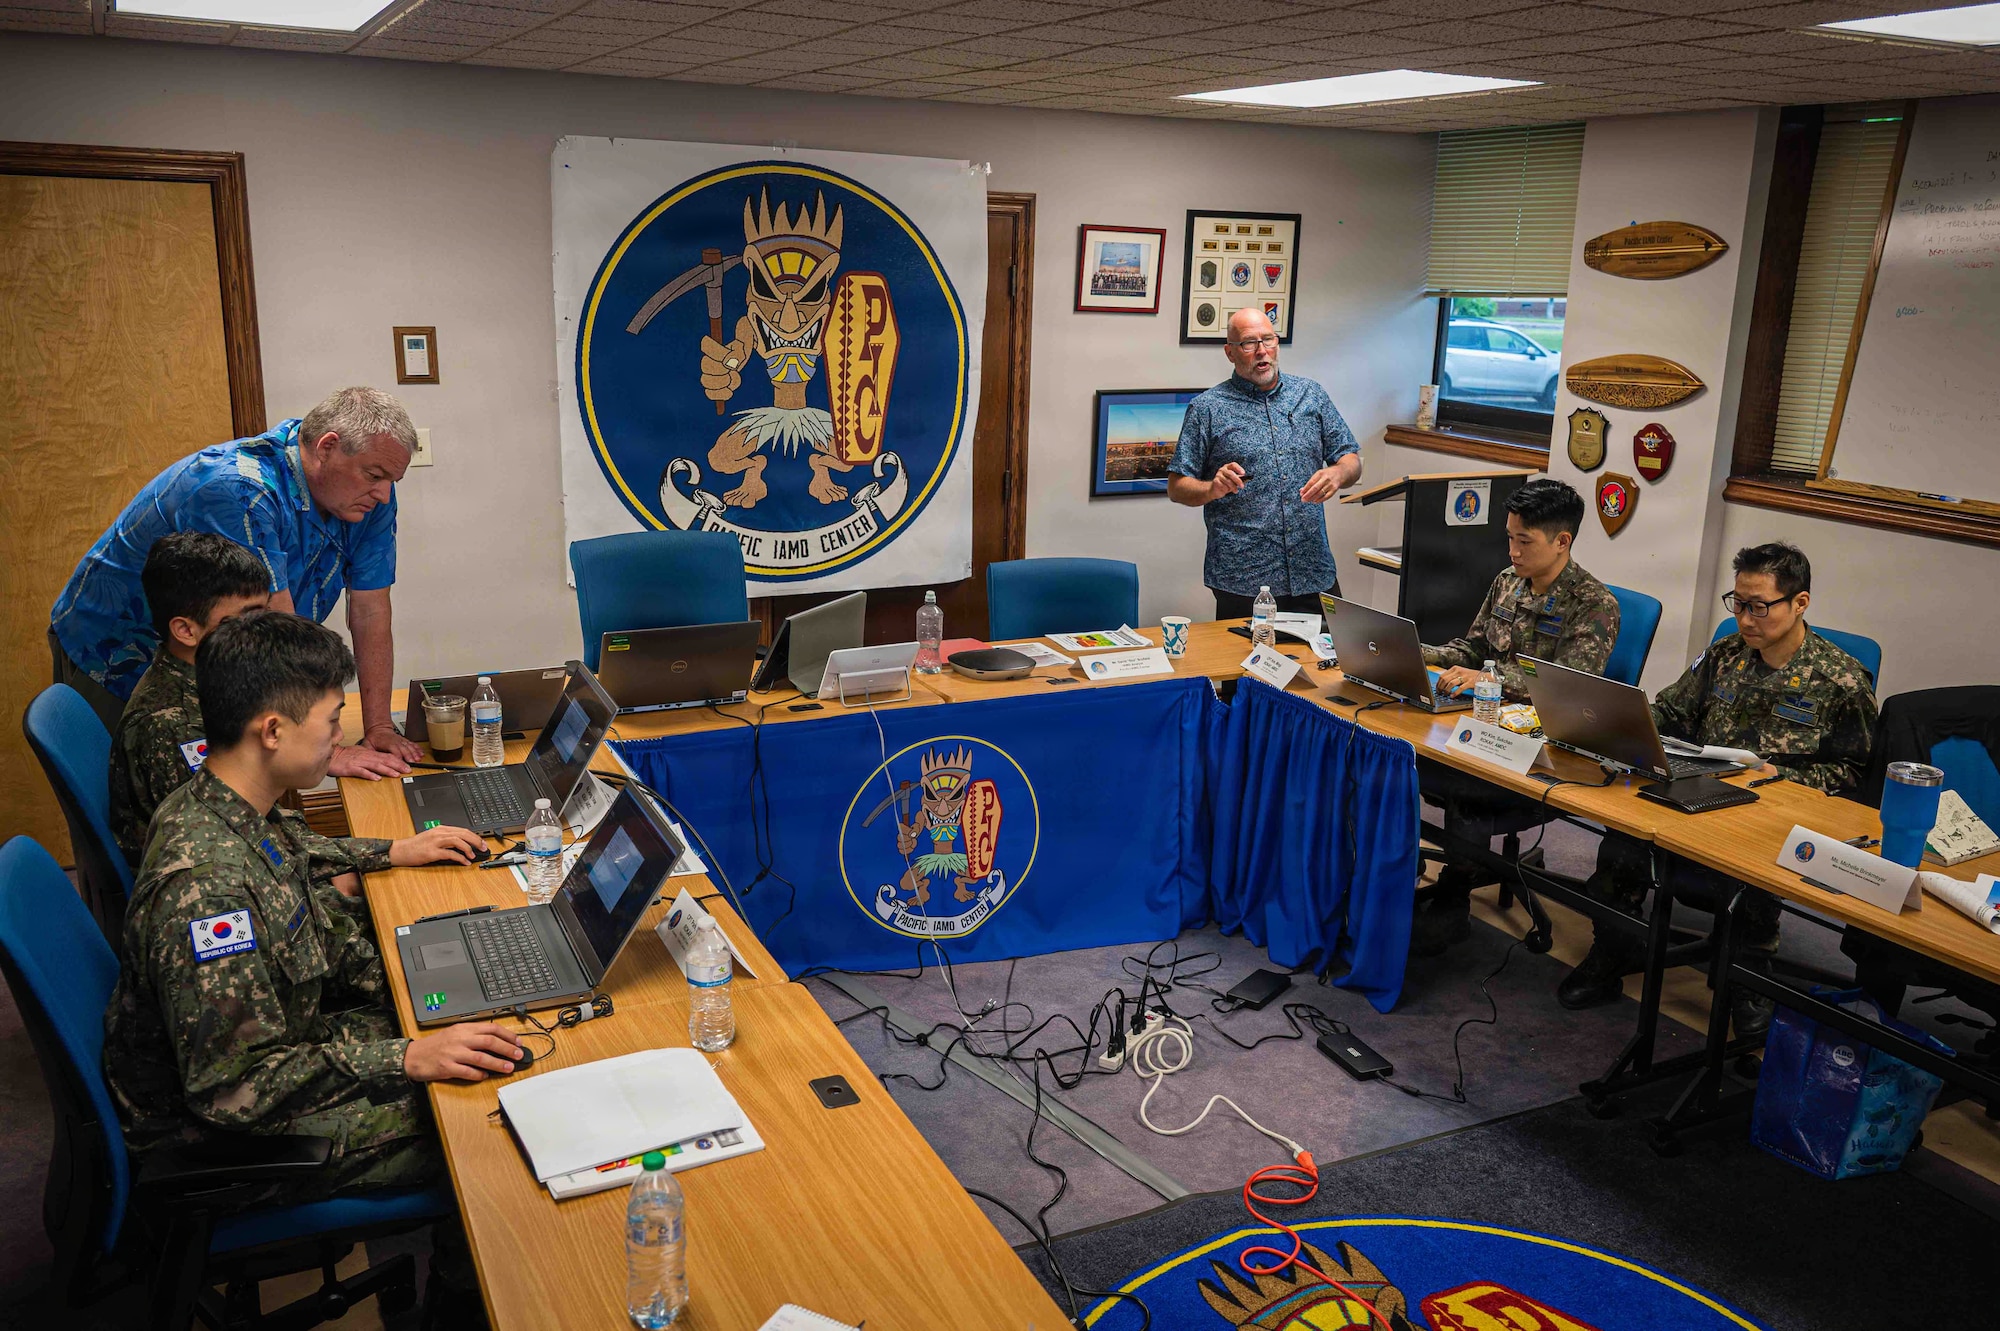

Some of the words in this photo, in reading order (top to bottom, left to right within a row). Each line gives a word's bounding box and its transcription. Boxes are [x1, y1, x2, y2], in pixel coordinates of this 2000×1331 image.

[820, 514, 874, 553] CENTER
[1840, 859, 1860, 872] Michelle
[897, 913, 928, 931] PACIFIC
[960, 903, 987, 929] CENTER
[200, 948, 226, 959] REPUBLIC
[226, 945, 234, 953] OF
[234, 942, 253, 951] KOREA
[1834, 1048, 1853, 1059] ABC
